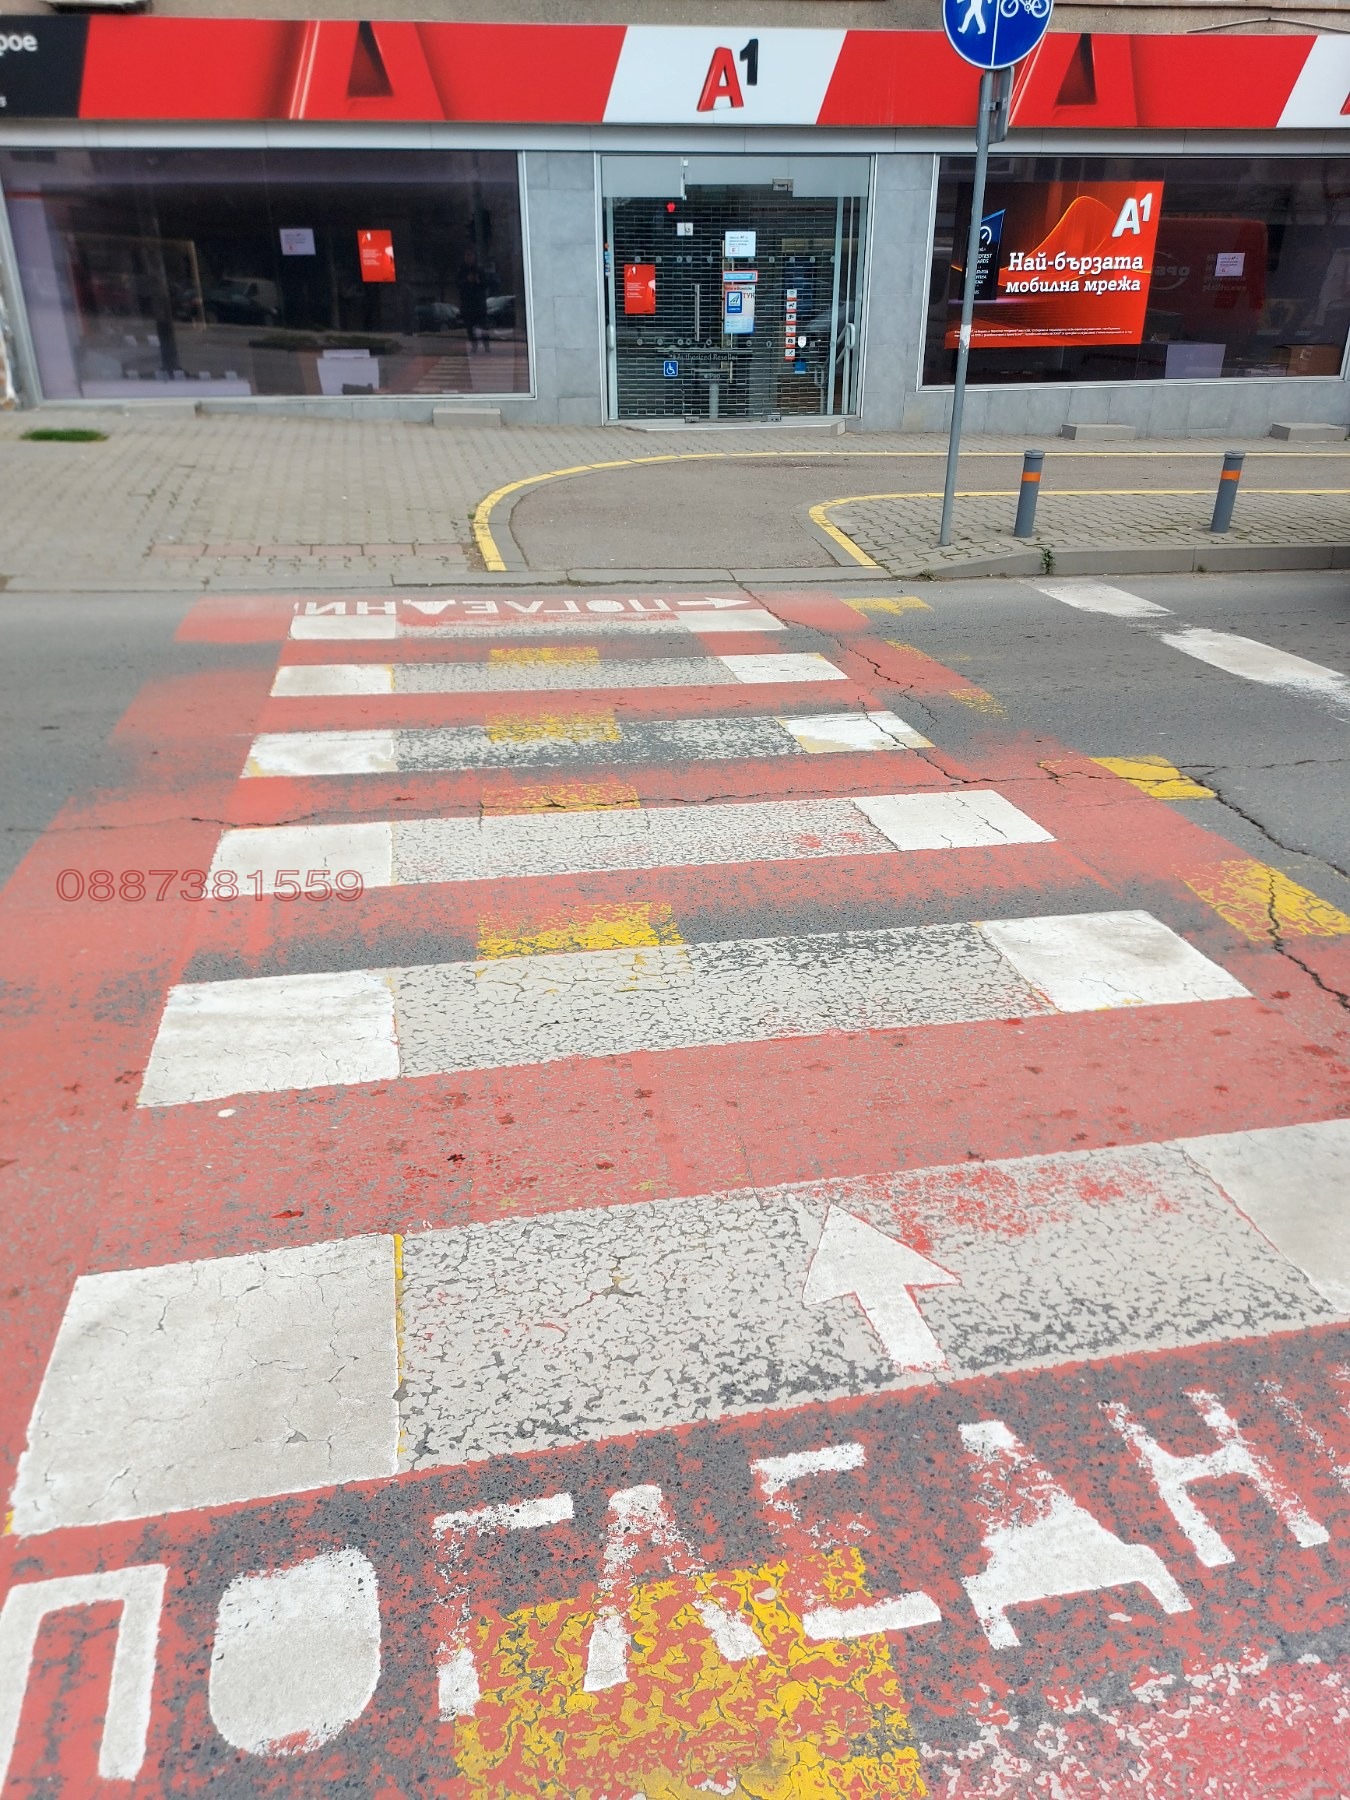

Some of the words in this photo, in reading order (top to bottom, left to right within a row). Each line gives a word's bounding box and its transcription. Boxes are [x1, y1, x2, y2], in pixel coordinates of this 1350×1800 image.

[696, 38, 759, 112] A1
[1111, 193, 1153, 238] A1
[1007, 251, 1143, 275] Най-бързата
[1005, 276, 1079, 293] мобилна
[1083, 275, 1140, 295] мрежа
